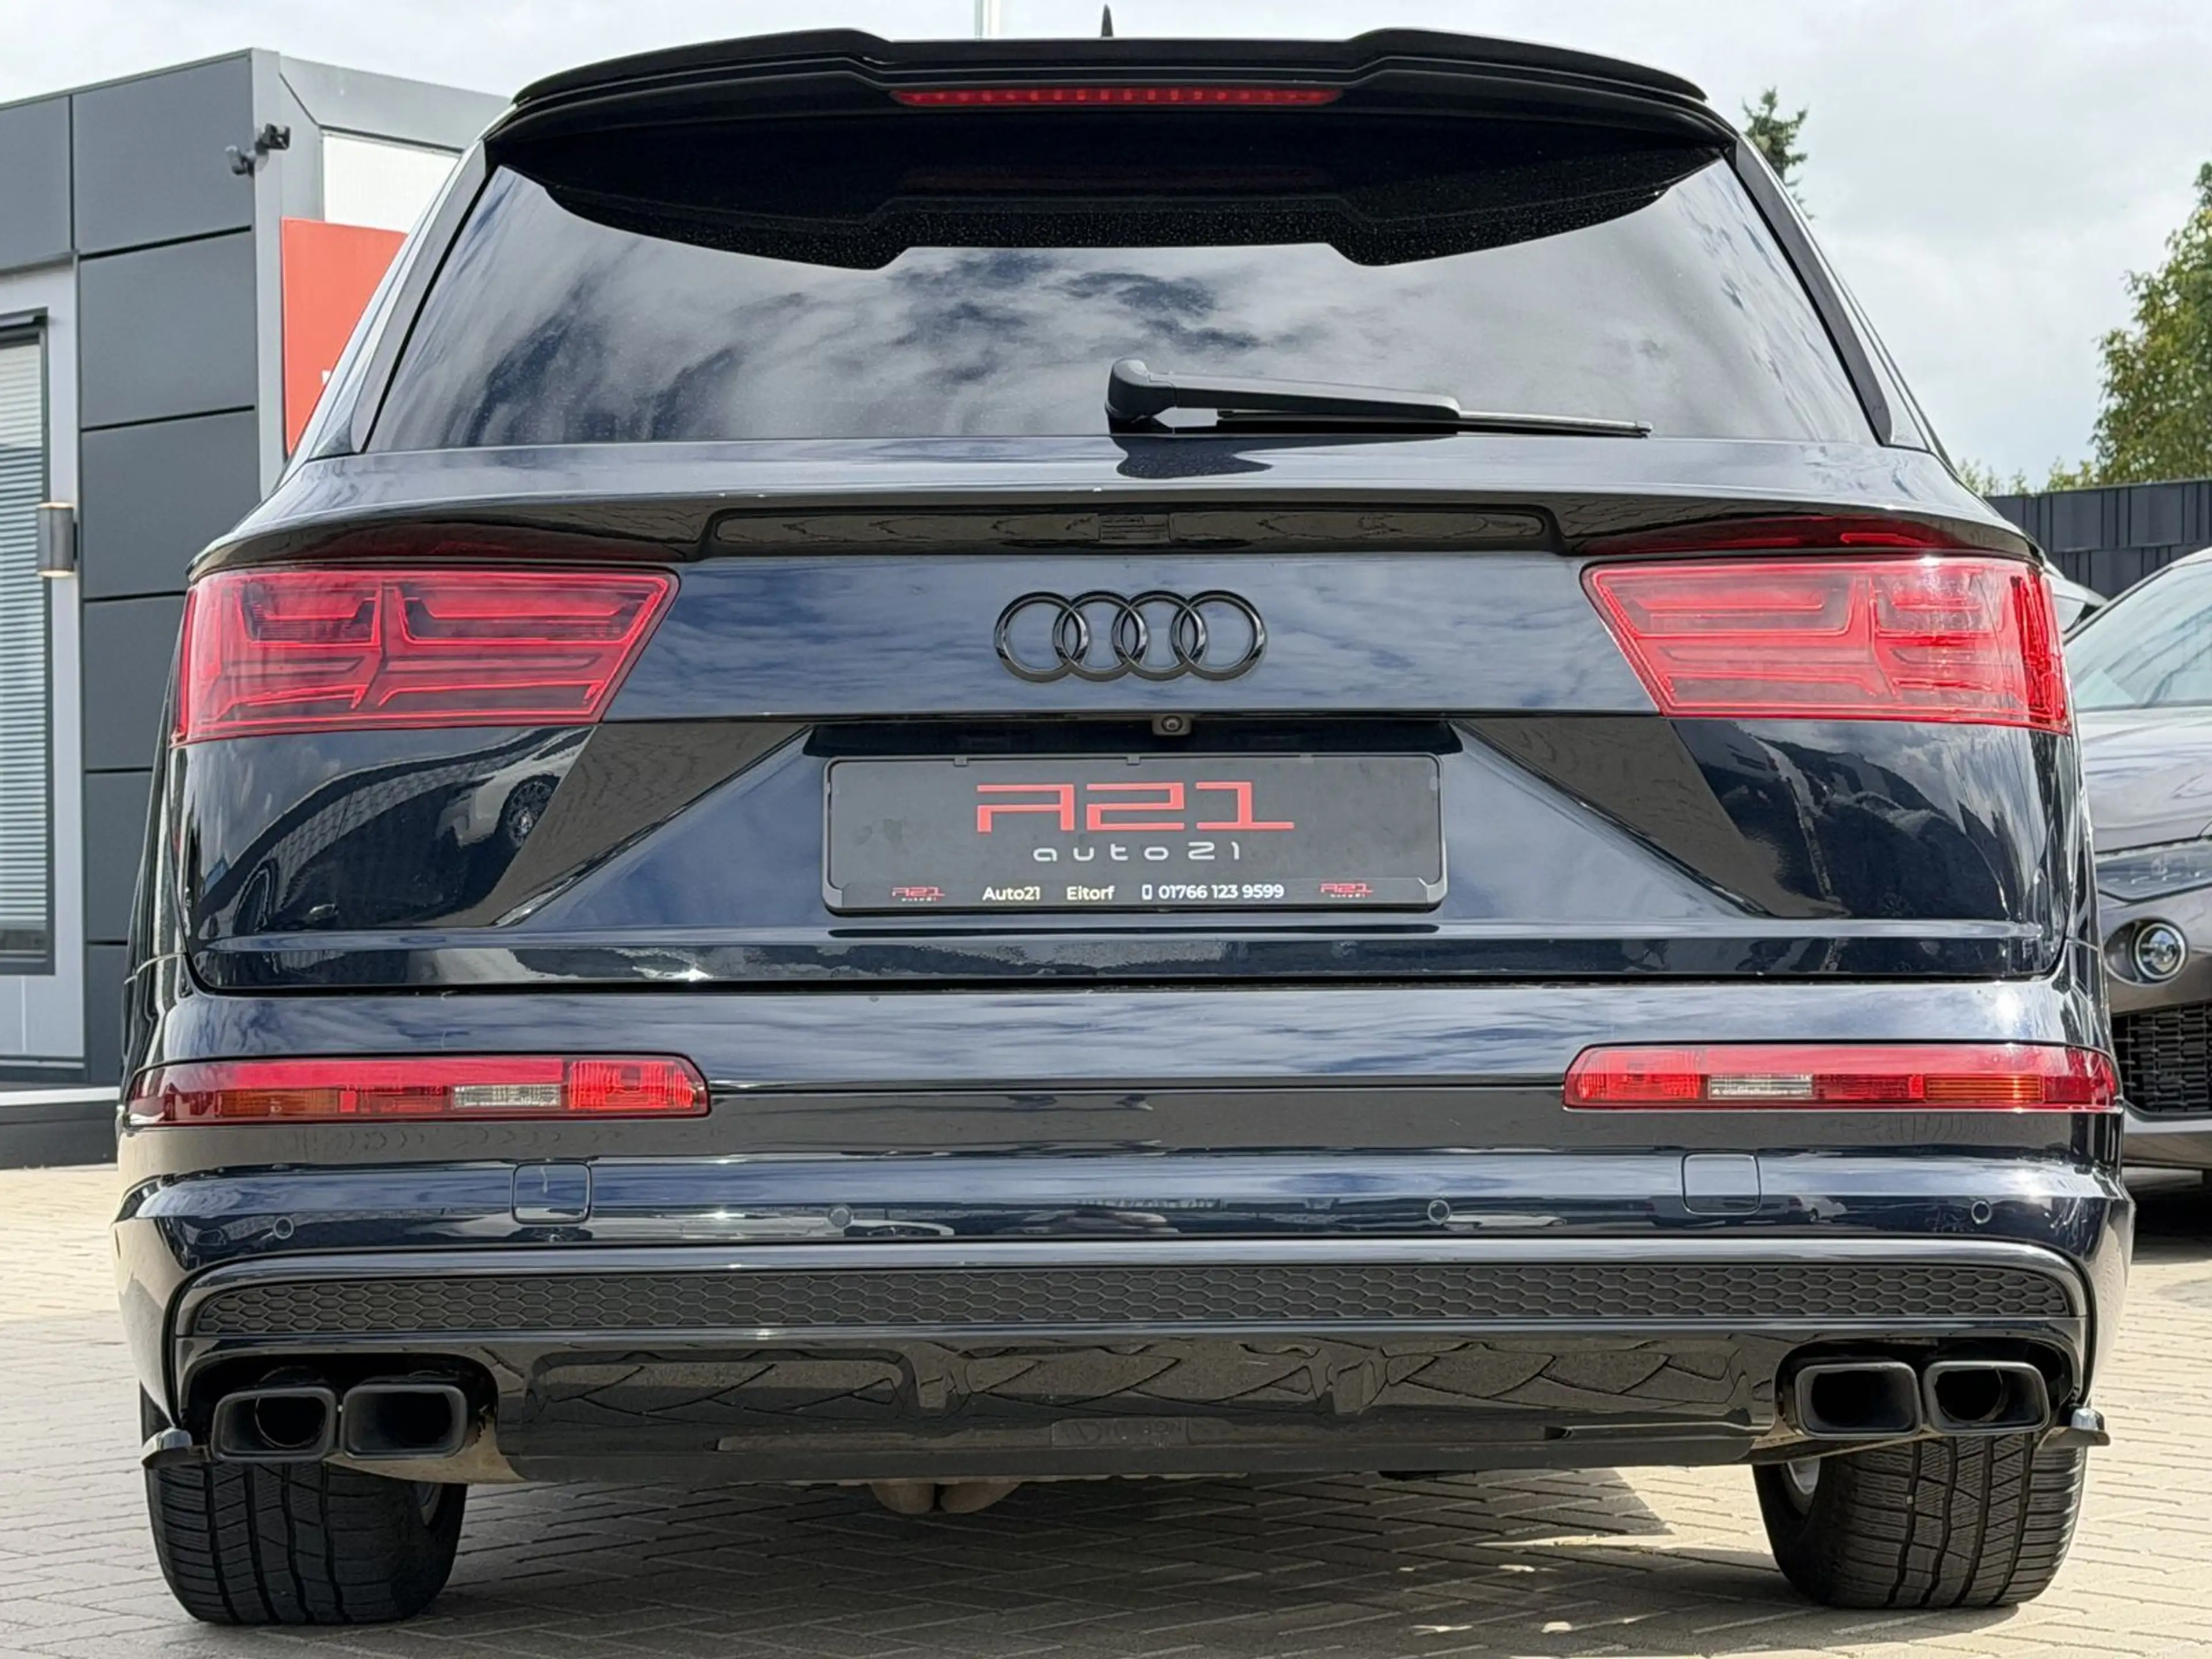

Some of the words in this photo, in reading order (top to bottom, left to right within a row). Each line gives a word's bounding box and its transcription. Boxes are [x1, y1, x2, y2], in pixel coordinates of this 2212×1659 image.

[977, 782, 1294, 832] A21
[982, 887, 1041, 902] Auto21
[1066, 885, 1115, 900] Eitorf
[1158, 884, 1209, 899] 01766
[1211, 884, 1238, 899] 123
[1241, 884, 1285, 899] 9599
